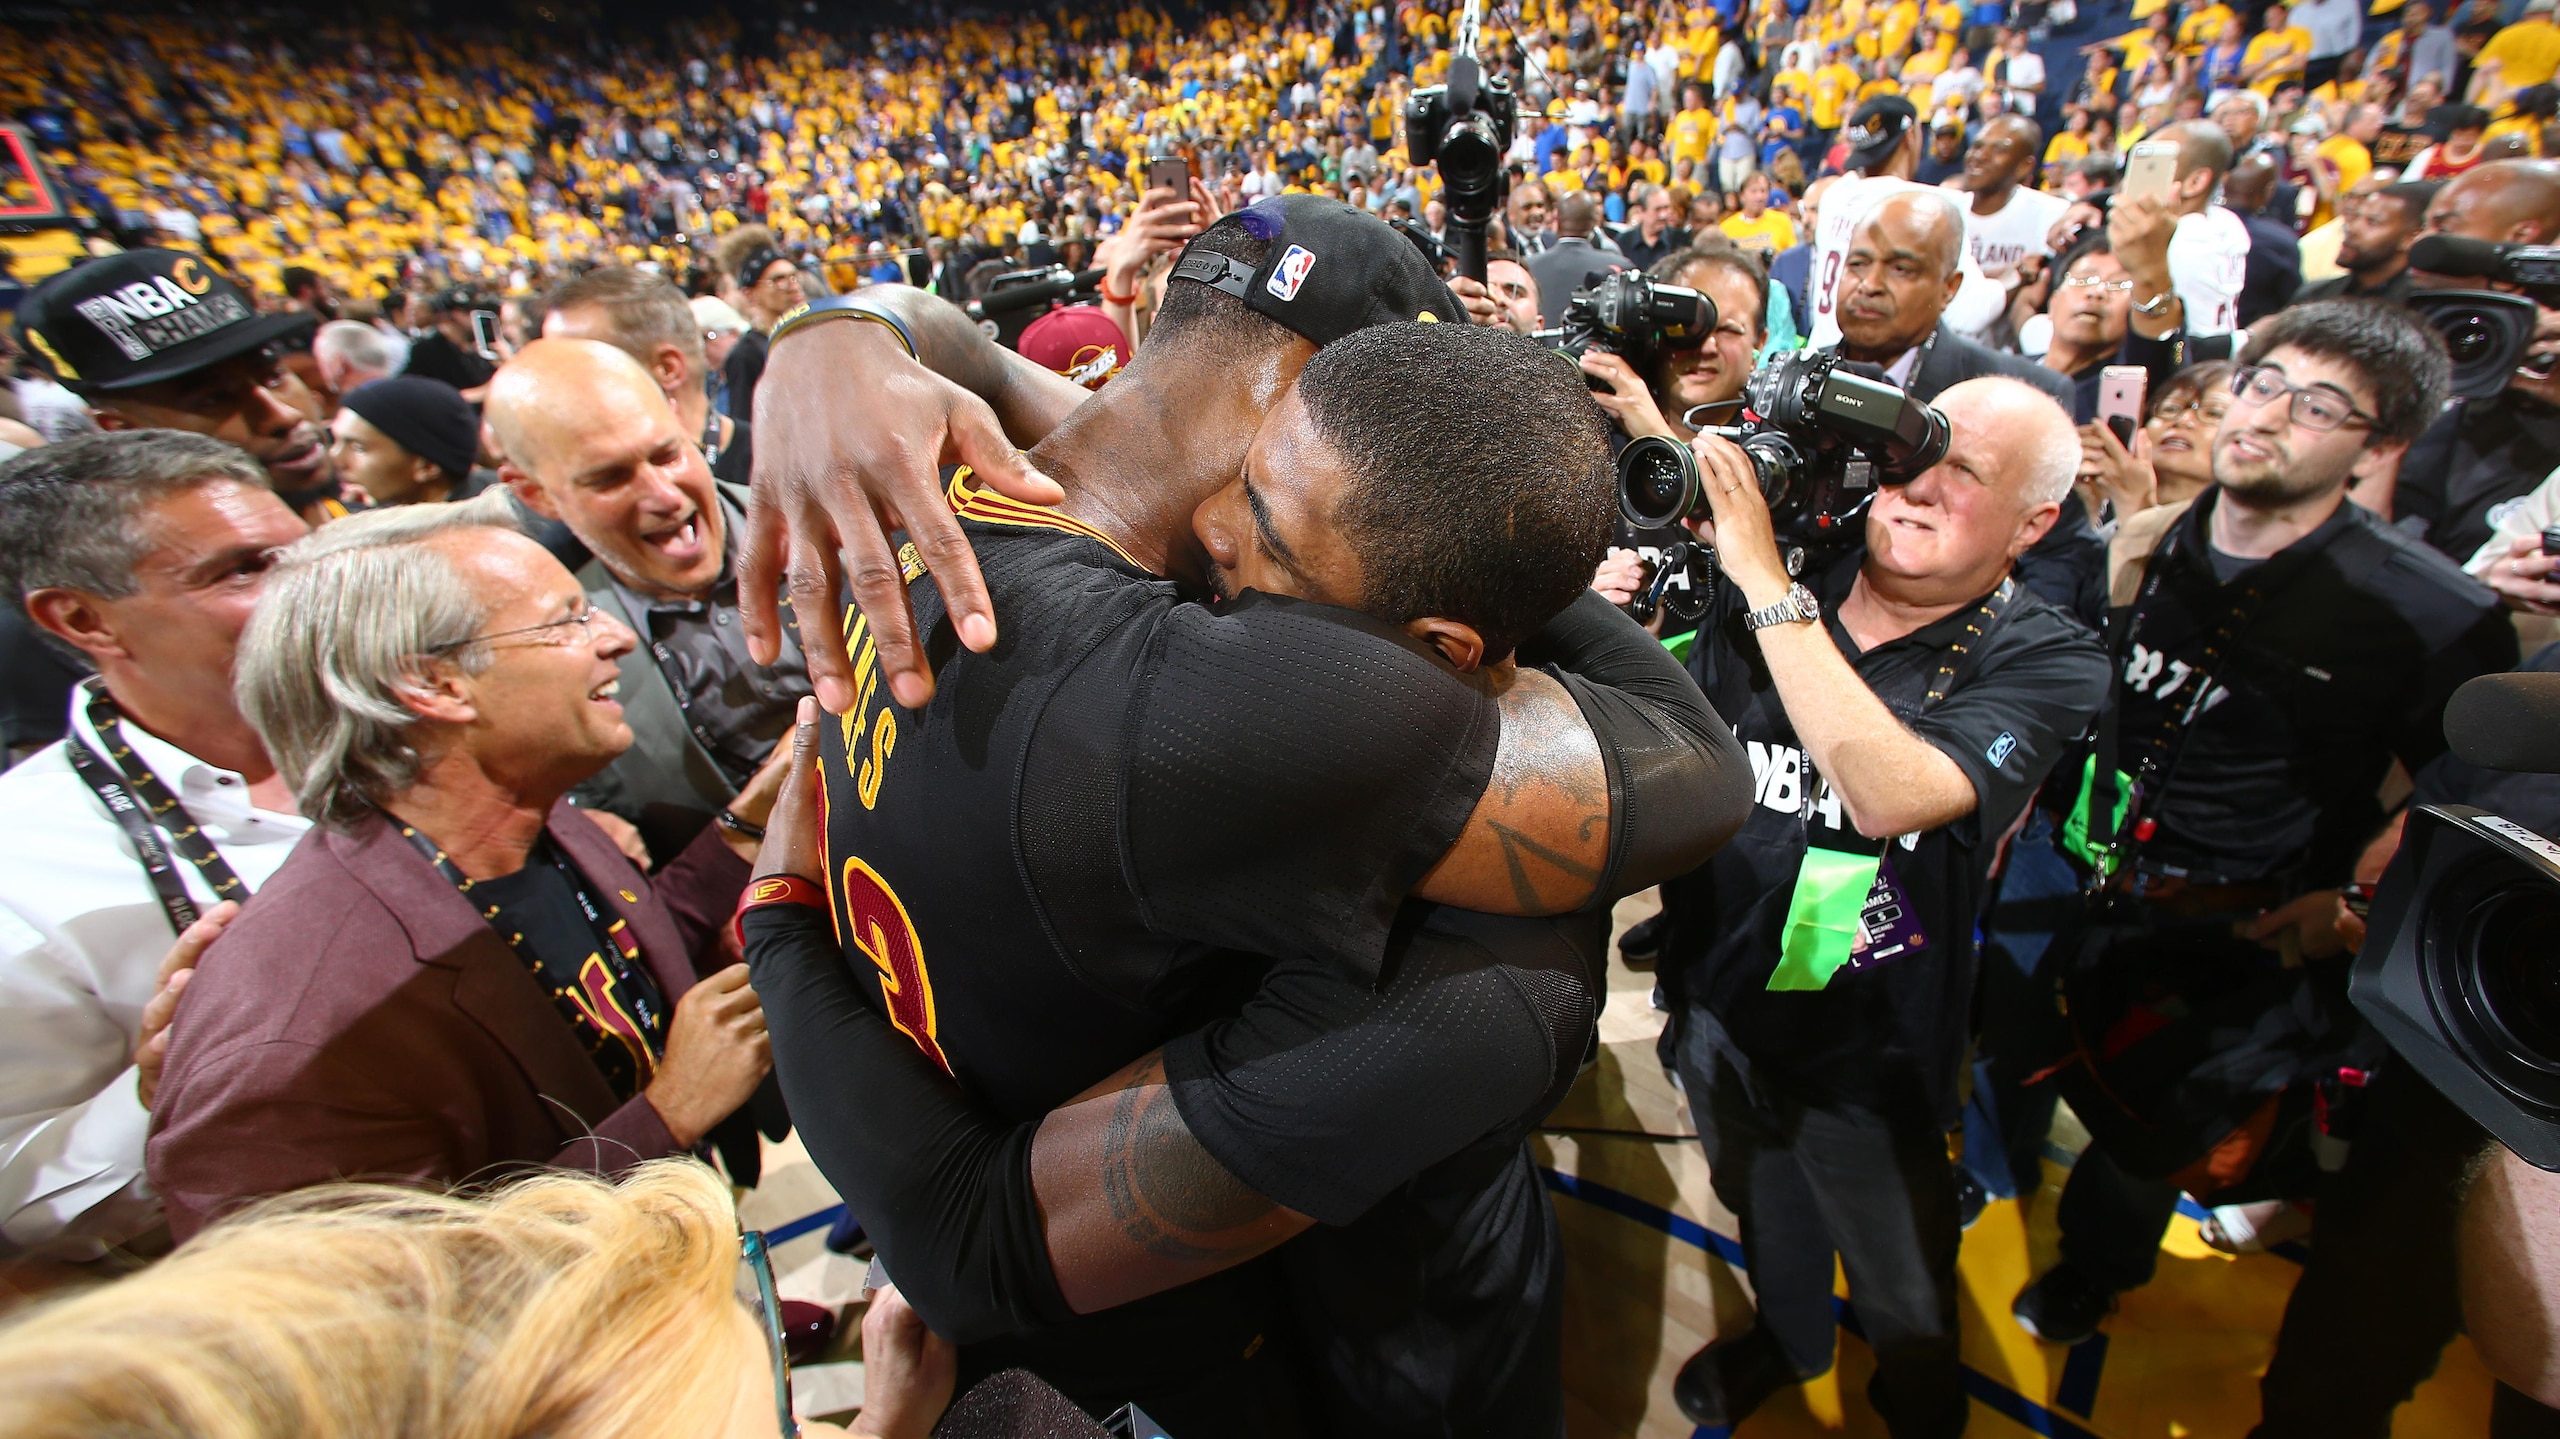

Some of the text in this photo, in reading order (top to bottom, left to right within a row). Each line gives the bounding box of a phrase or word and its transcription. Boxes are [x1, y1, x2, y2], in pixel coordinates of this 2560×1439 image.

[1270, 278, 1289, 297] NBA
[98, 275, 199, 327] NBA
[1834, 393, 1864, 408] SONY
[99, 783, 136, 813] 2016
[1861, 891, 1893, 912] AMES
